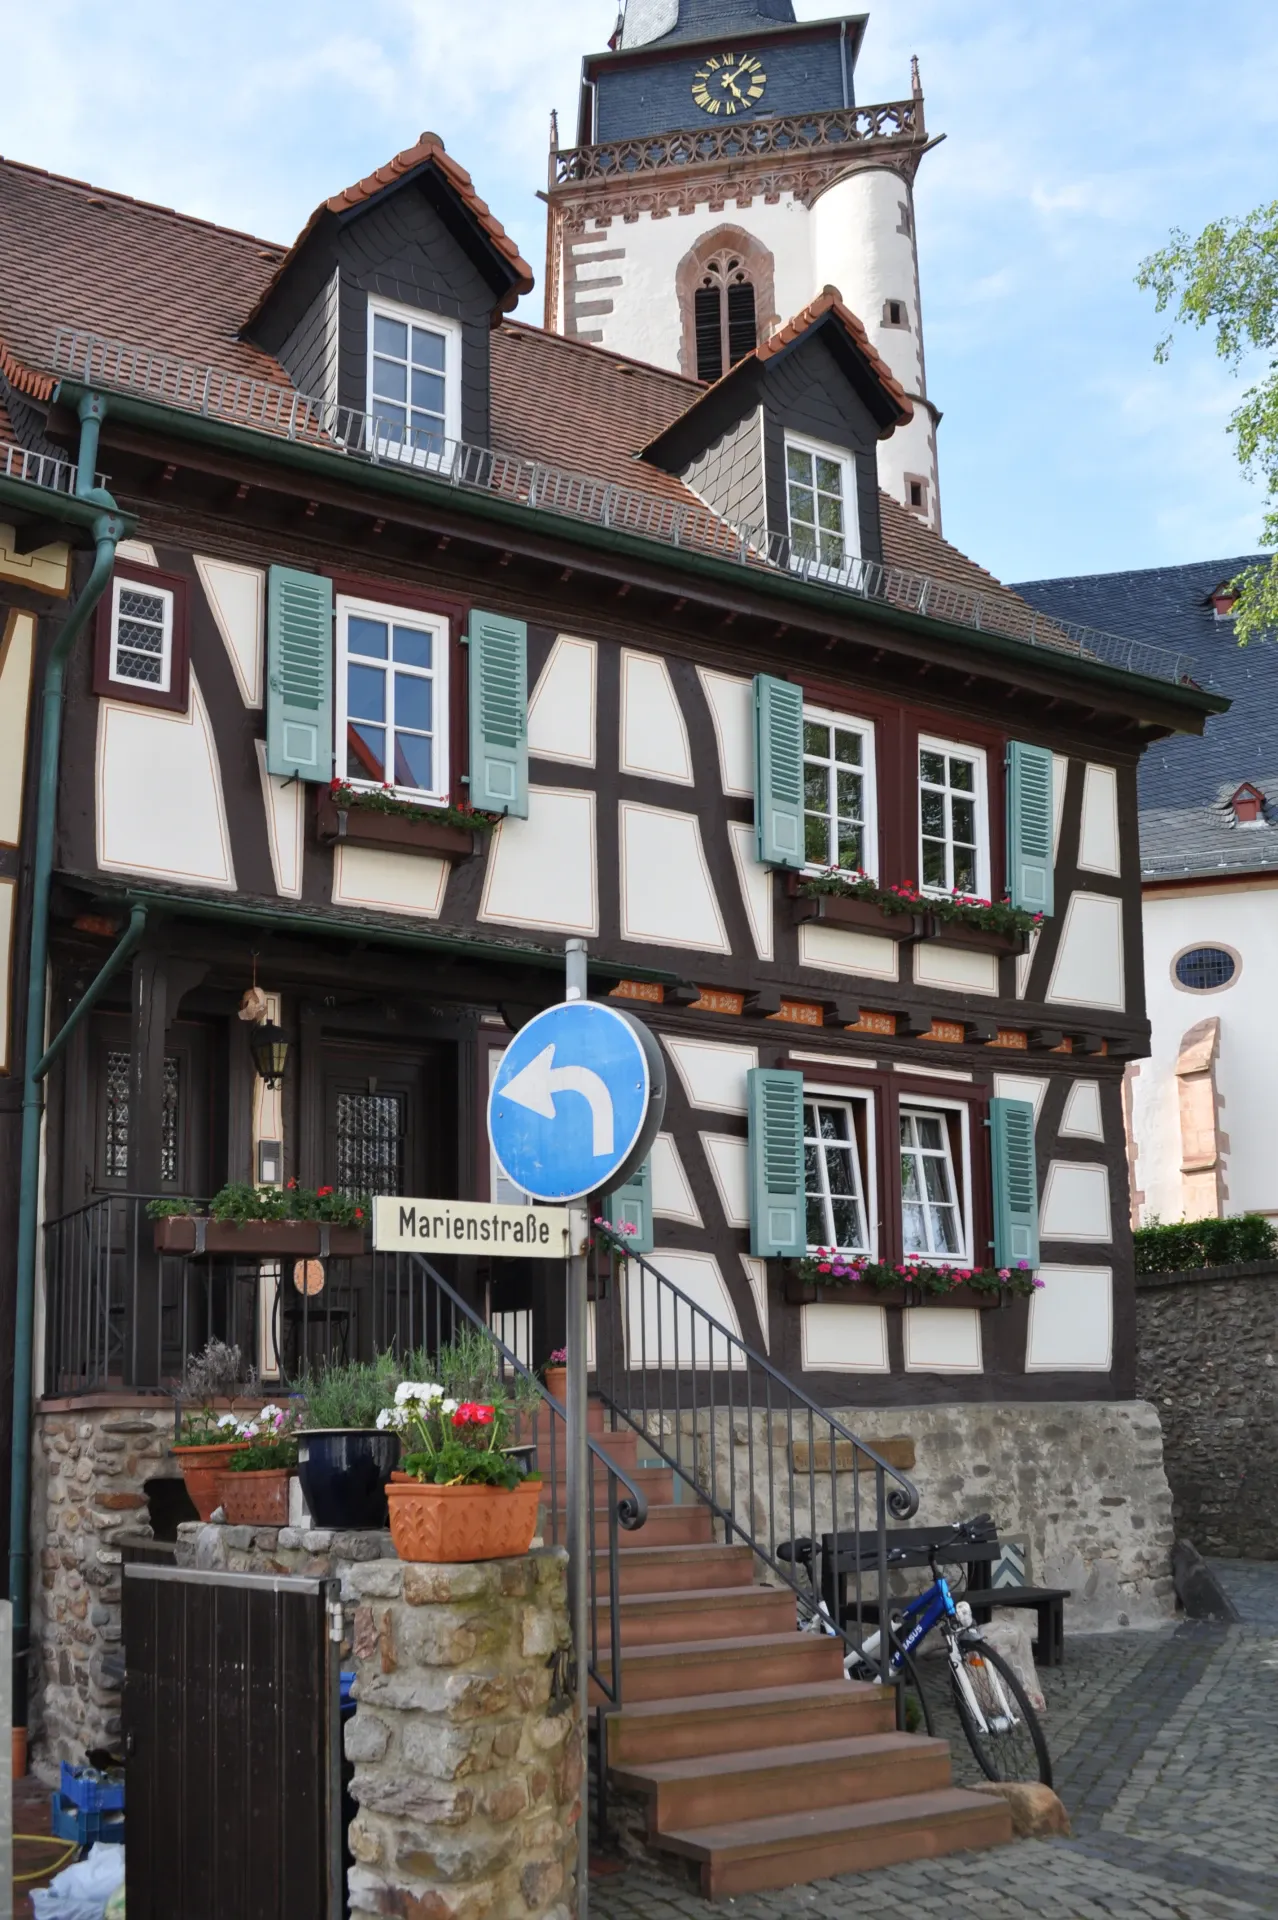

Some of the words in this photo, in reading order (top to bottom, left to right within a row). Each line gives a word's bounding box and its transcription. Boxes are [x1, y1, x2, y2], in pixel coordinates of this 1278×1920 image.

[722, 52, 734, 66] XII
[738, 53, 748, 67] I
[694, 70, 710, 80] X
[399, 1205, 550, 1244] Marienstraße
[894, 1624, 923, 1661] PASUS
